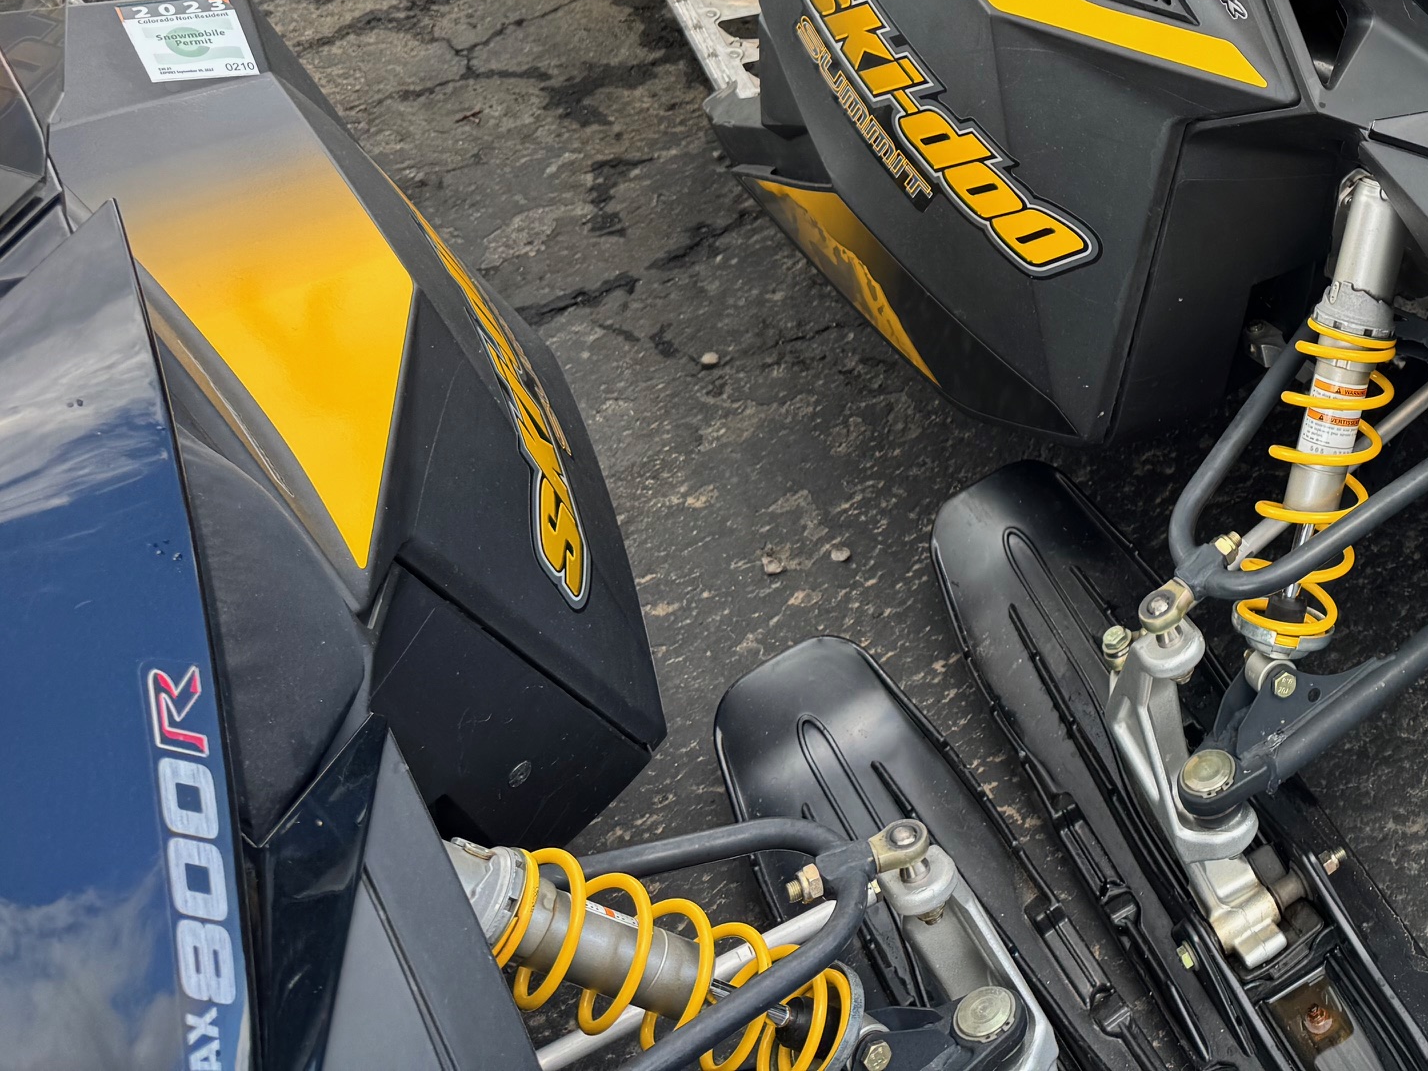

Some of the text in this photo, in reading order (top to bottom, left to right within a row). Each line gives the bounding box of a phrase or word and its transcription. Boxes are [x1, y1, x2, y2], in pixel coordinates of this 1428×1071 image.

[137, 11, 230, 25] Colorado Non-Resident
[155, 29, 226, 42] Snowmobile
[174, 37, 214, 47] Permit
[224, 61, 255, 72] 0210
[147, 664, 237, 1006] 800R
